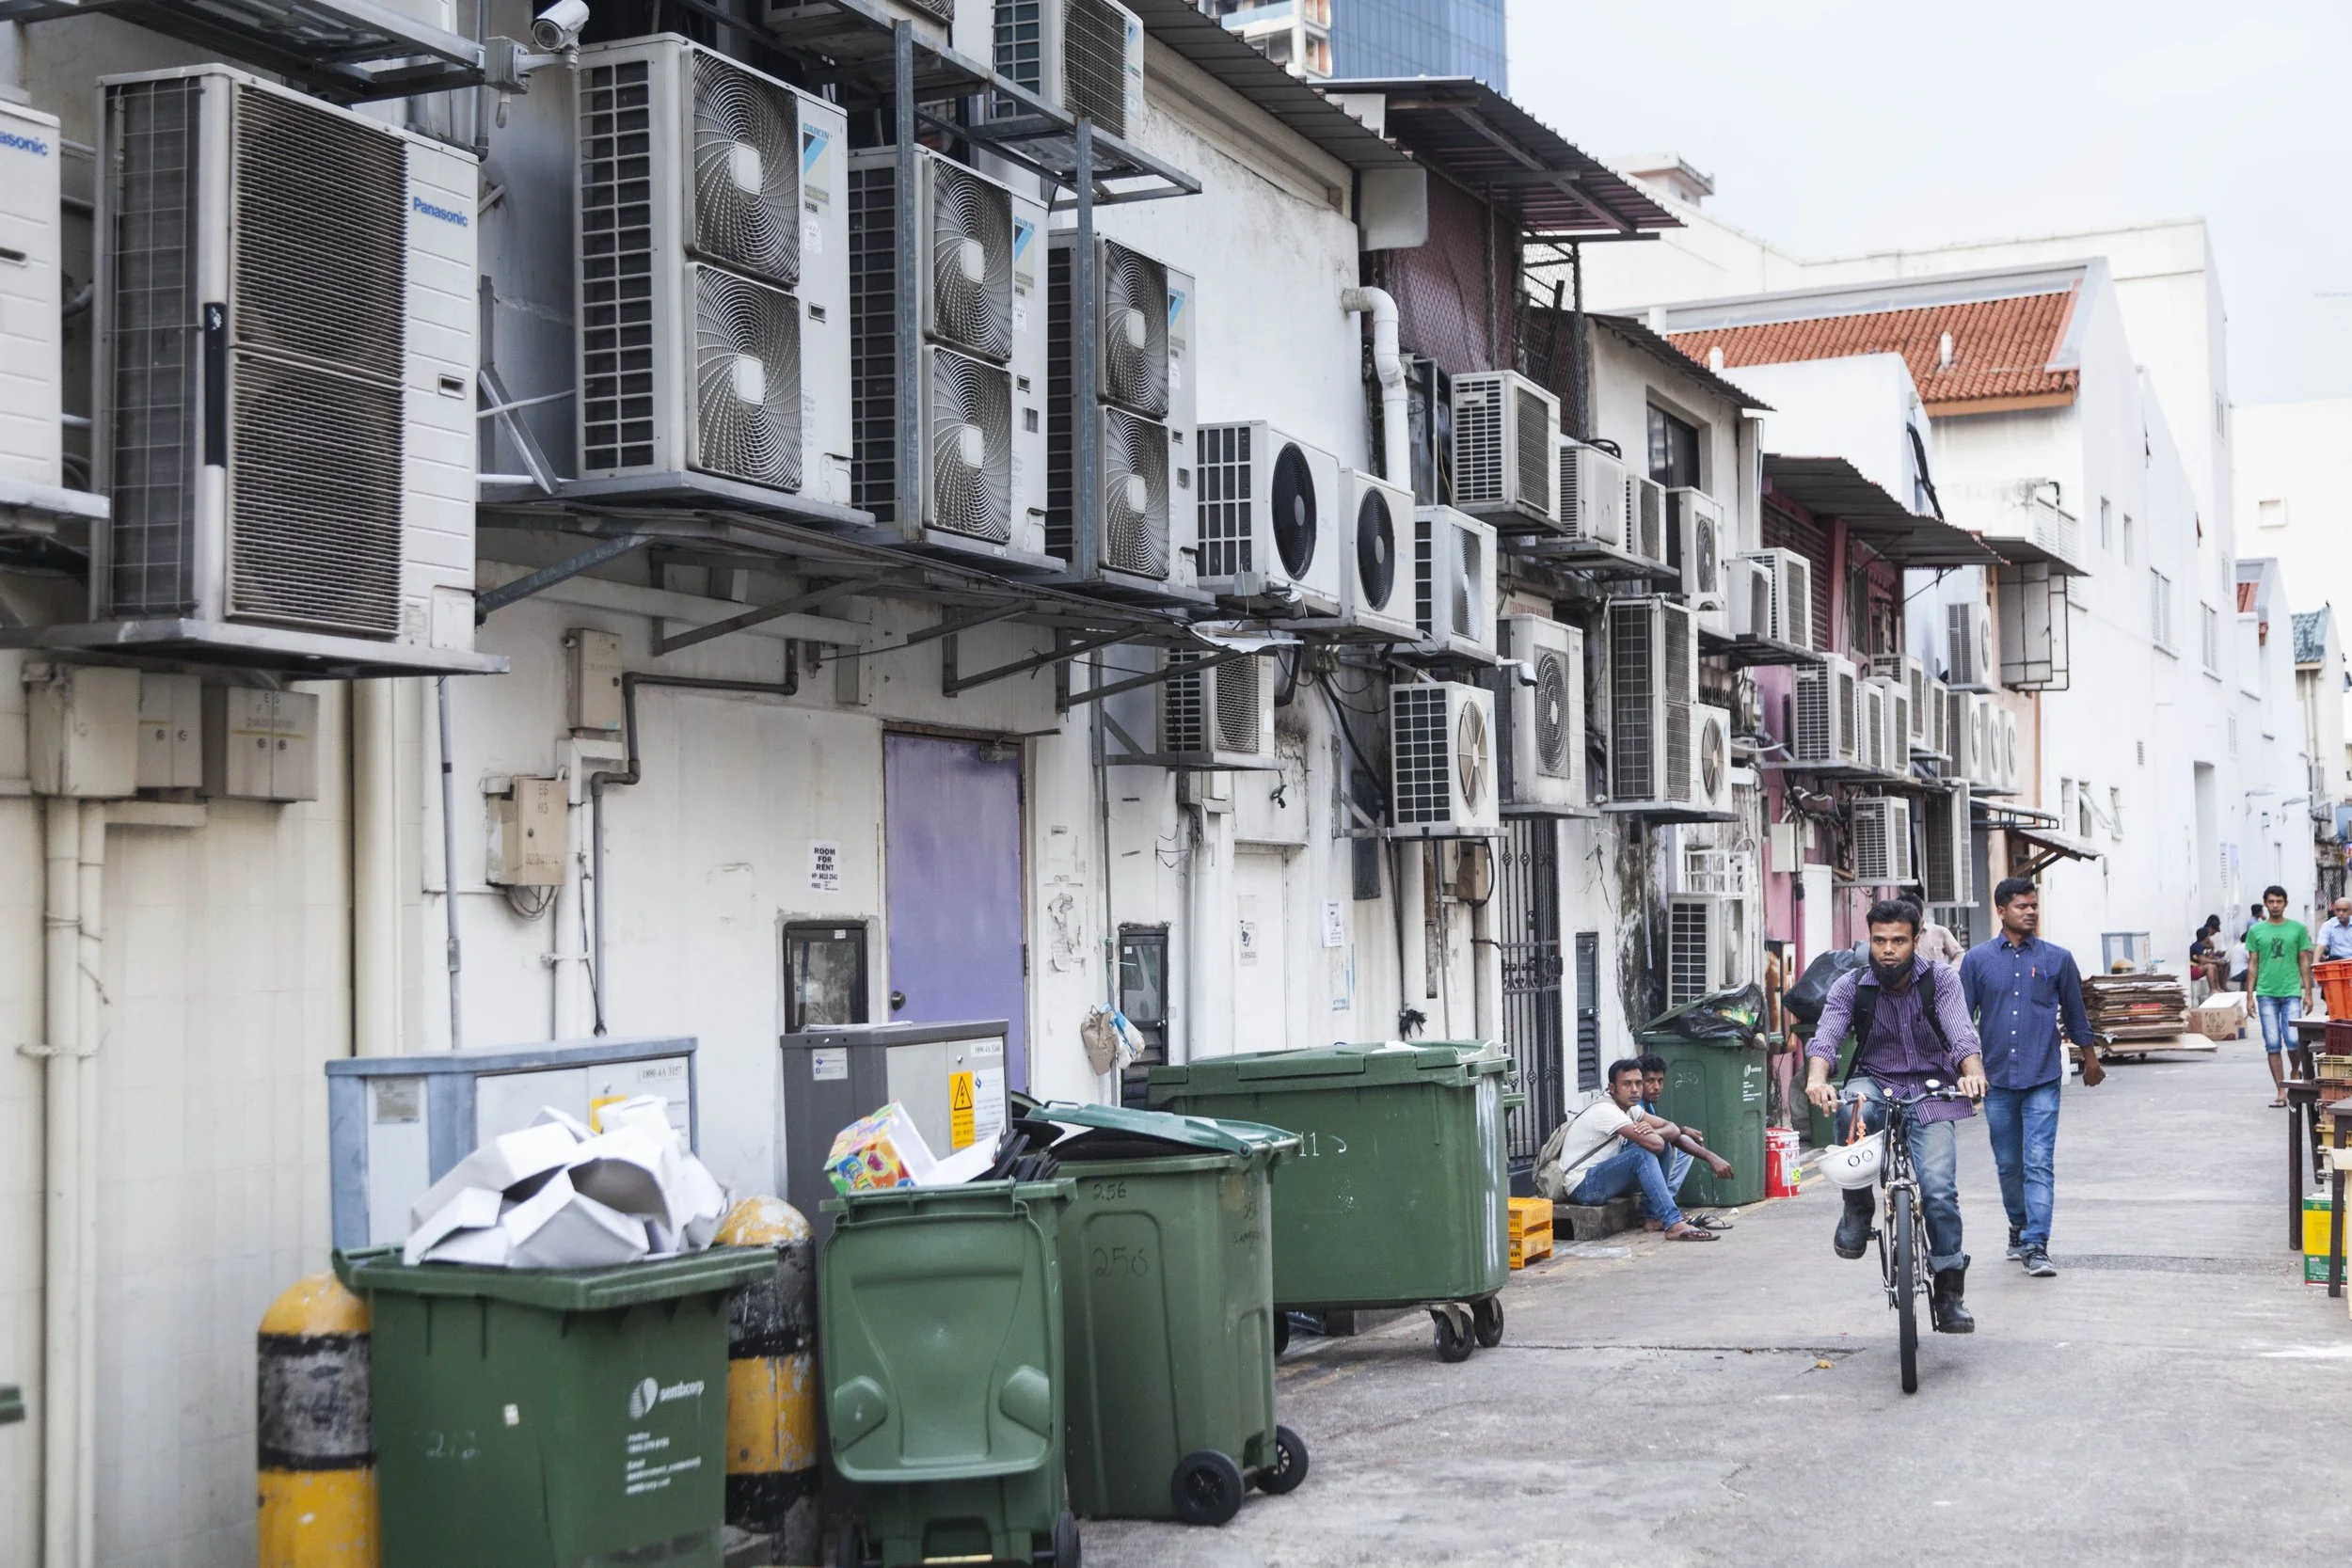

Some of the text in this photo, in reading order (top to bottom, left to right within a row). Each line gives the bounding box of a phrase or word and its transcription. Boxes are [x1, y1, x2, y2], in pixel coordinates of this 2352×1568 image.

[803, 121, 830, 140] DAIKIN
[413, 197, 469, 228] Panasonic
[814, 847, 835, 855] ROOM
[818, 855, 833, 863] FOR
[1093, 1181, 1127, 1201] 256
[1093, 1246, 1149, 1277] 256
[660, 1380, 705, 1402] sembcorp
